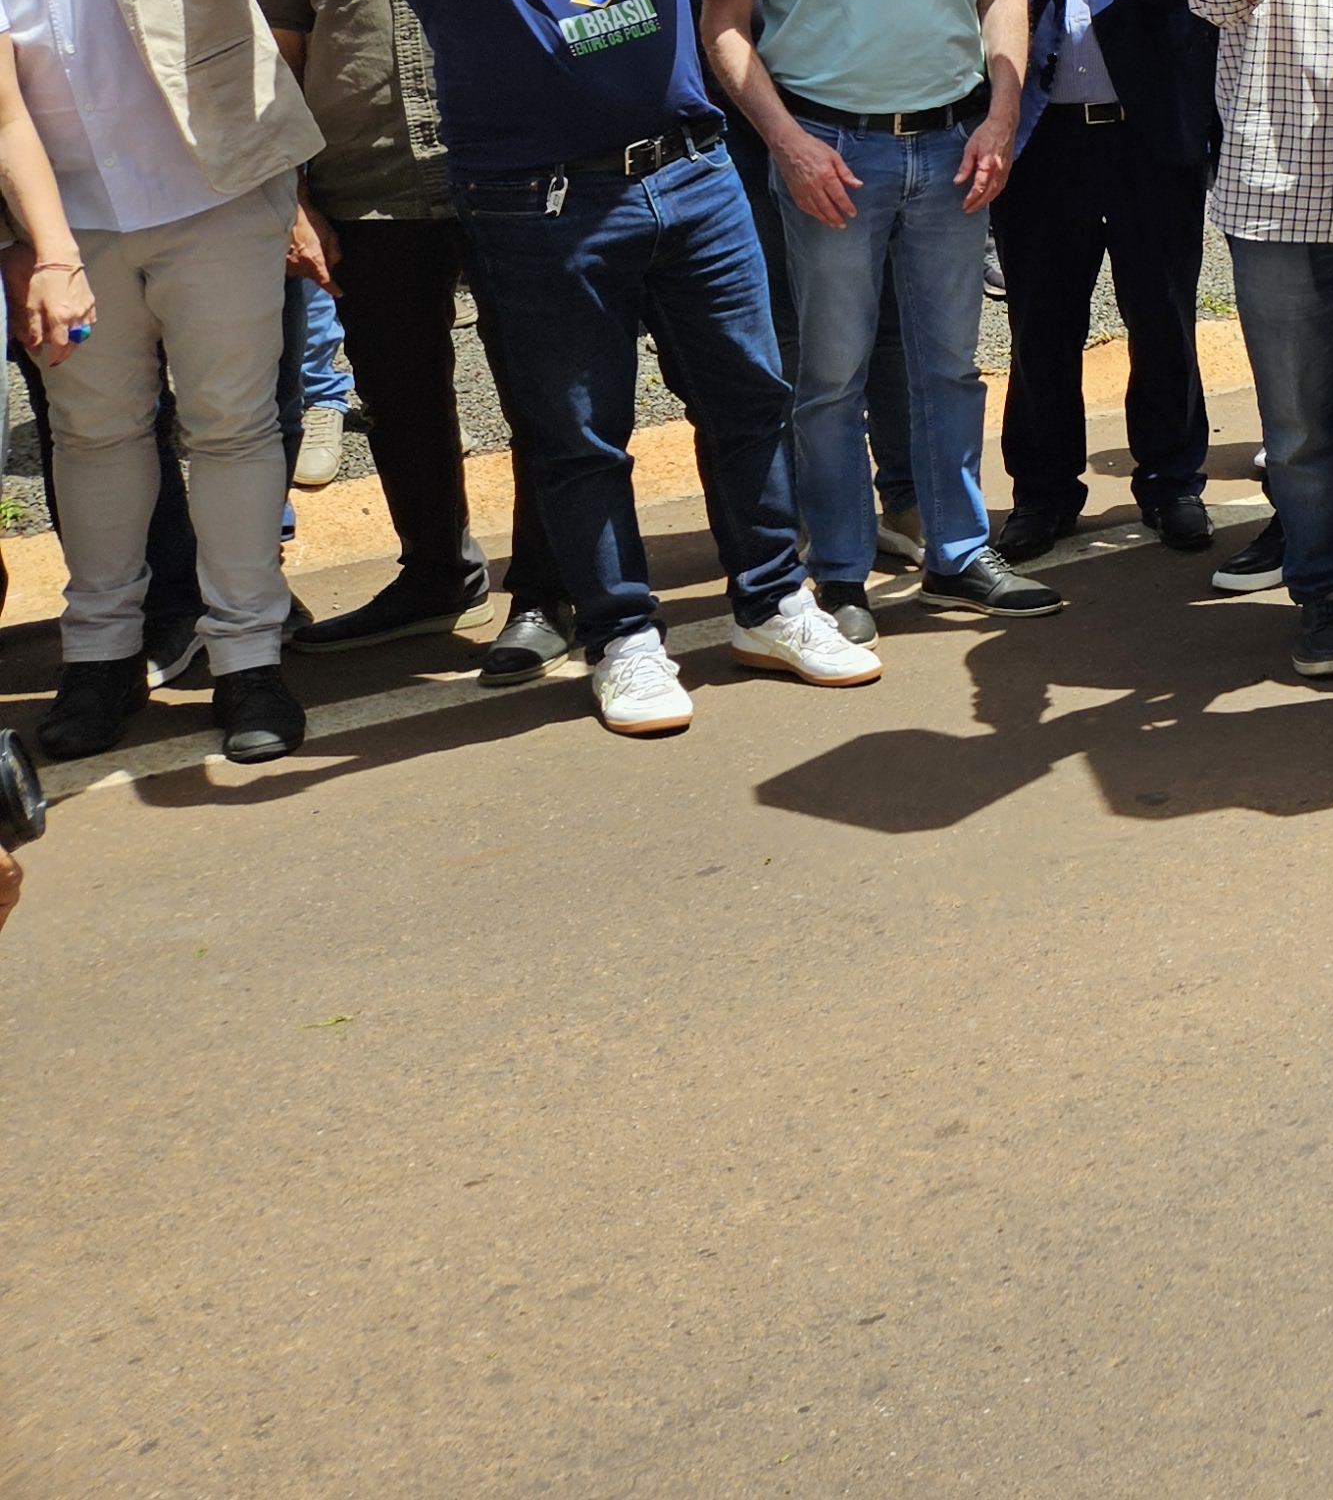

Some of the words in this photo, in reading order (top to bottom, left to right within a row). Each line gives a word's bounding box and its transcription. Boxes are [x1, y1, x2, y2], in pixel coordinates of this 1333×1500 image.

[559, 18, 580, 44] O
[607, 30, 624, 46] OS
[623, 19, 657, 40] POLOS
